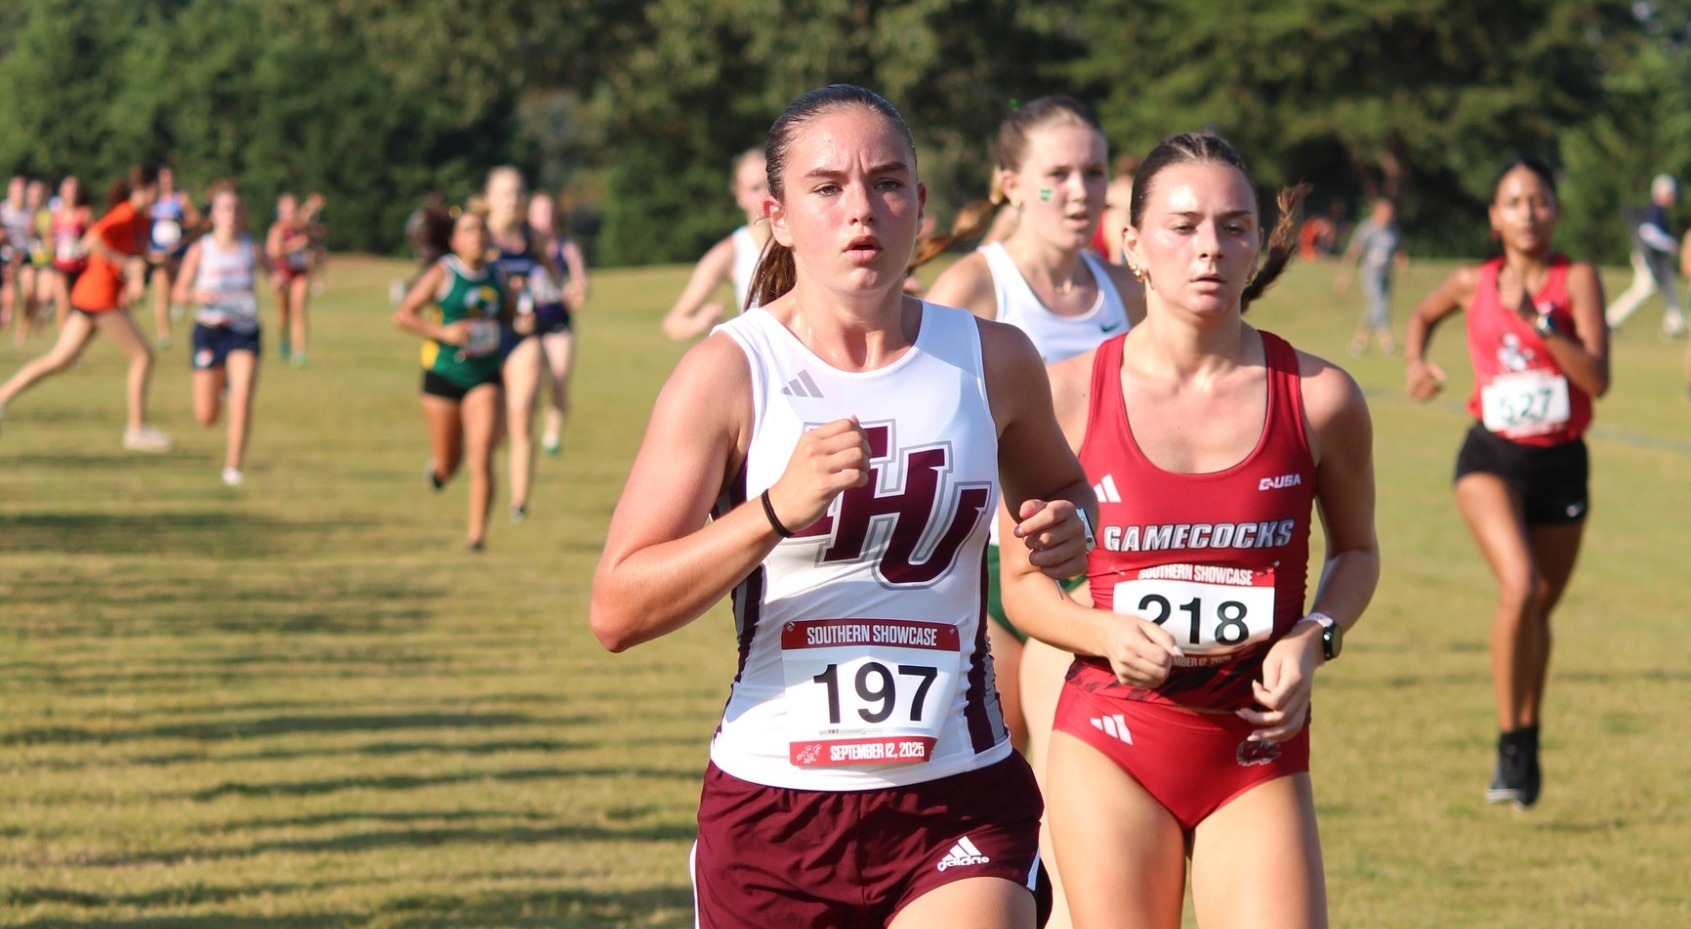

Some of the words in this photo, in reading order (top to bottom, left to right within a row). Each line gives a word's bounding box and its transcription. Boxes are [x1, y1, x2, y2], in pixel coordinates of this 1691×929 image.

[1103, 519, 1295, 551] GAMECOCKS
[1138, 564, 1193, 580] SOUTHERN
[1194, 565, 1253, 585] SHOWCASE
[1138, 594, 1249, 645] 218
[807, 625, 870, 645] SOUTHERN
[873, 625, 937, 646] SHOWCASE
[813, 661, 938, 724] 197
[830, 743, 884, 761] SEPTEMBER
[899, 741, 925, 758] 2025
